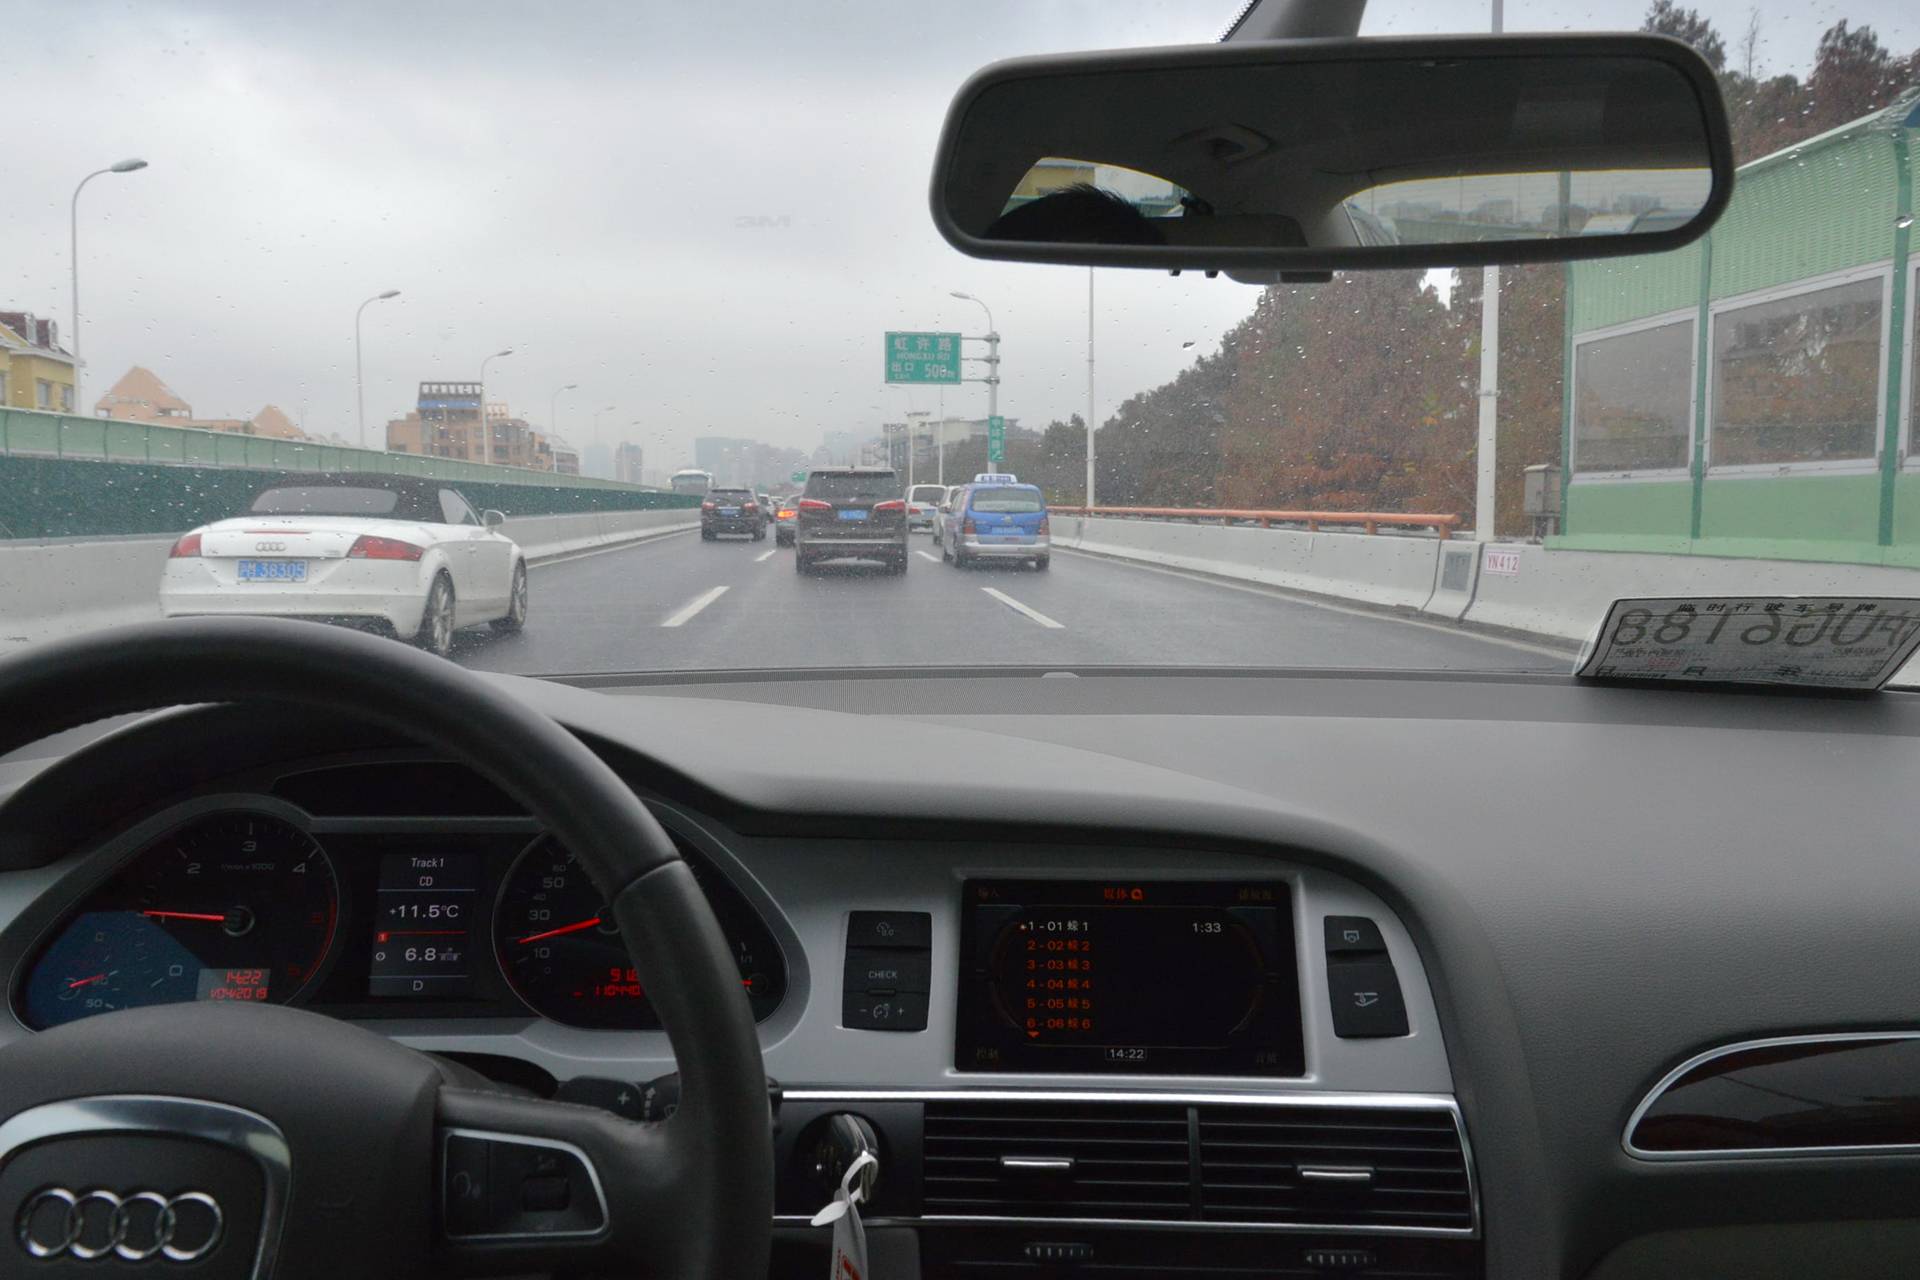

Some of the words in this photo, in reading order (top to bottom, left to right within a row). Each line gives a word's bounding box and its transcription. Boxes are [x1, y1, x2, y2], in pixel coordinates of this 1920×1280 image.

[1487, 554, 1518, 571] YN412
[242, 841, 257, 853] 3
[292, 862, 307, 874] 4
[411, 857, 437, 868] Track
[186, 863, 201, 875] 2
[419, 876, 433, 887] CD
[543, 877, 565, 889] 50
[528, 909, 551, 920] 30
[1047, 921, 1064, 931] 01
[1191, 922, 1222, 933] 1:33
[1047, 940, 1064, 950] 02
[405, 947, 437, 961] 6.8
[534, 948, 550, 959] 10
[1047, 960, 1064, 970] 03
[868, 970, 898, 979] CHECK
[412, 980, 424, 991] D
[1047, 979, 1064, 989] 04
[1047, 999, 1064, 1009] 05
[1047, 1018, 1064, 1029] 06
[1109, 1048, 1145, 1060] 14:22
